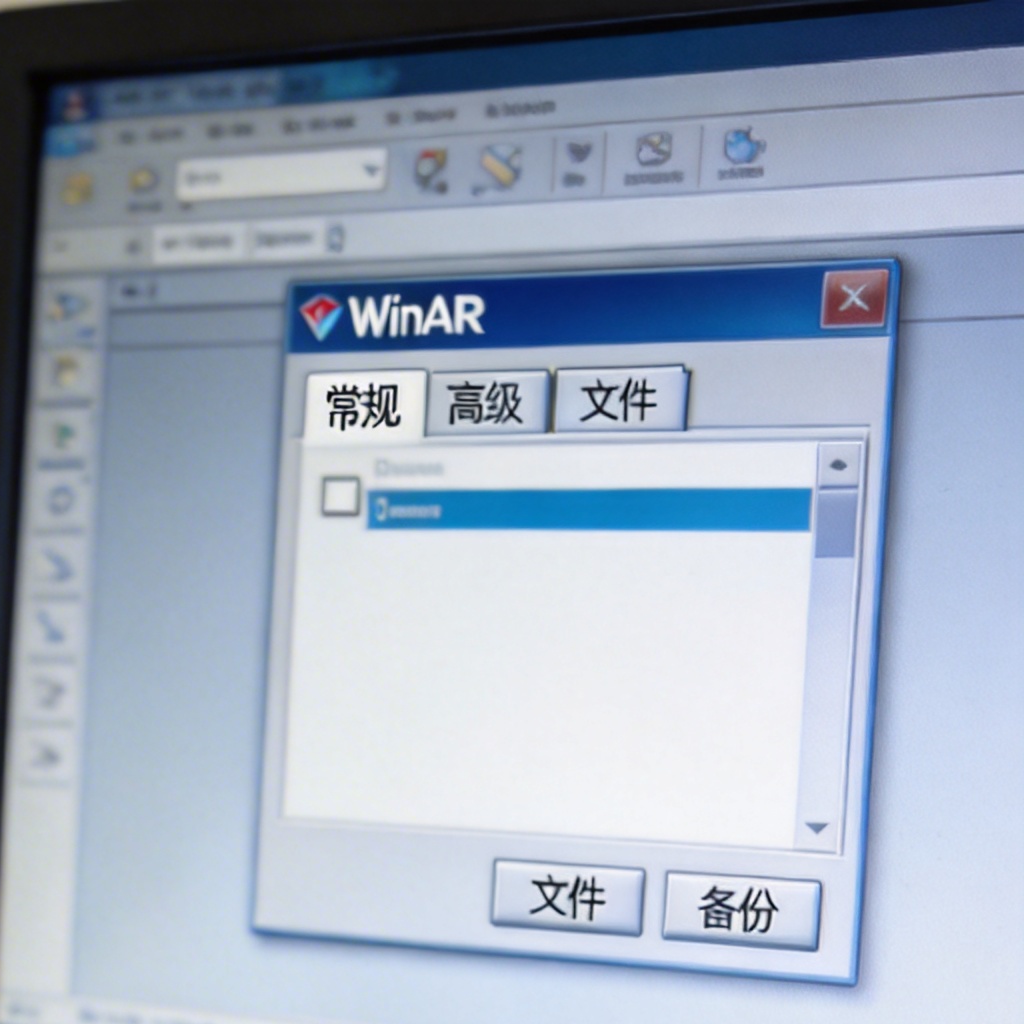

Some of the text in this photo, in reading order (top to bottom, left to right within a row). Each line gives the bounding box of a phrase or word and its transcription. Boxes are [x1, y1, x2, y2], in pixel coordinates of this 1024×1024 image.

[348, 294, 486, 338] WinAR
[326, 382, 401, 431] 常规
[447, 380, 524, 426] 高级
[579, 377, 658, 423] 文件
[530, 874, 607, 921] 文件
[698, 886, 779, 934] 备份
